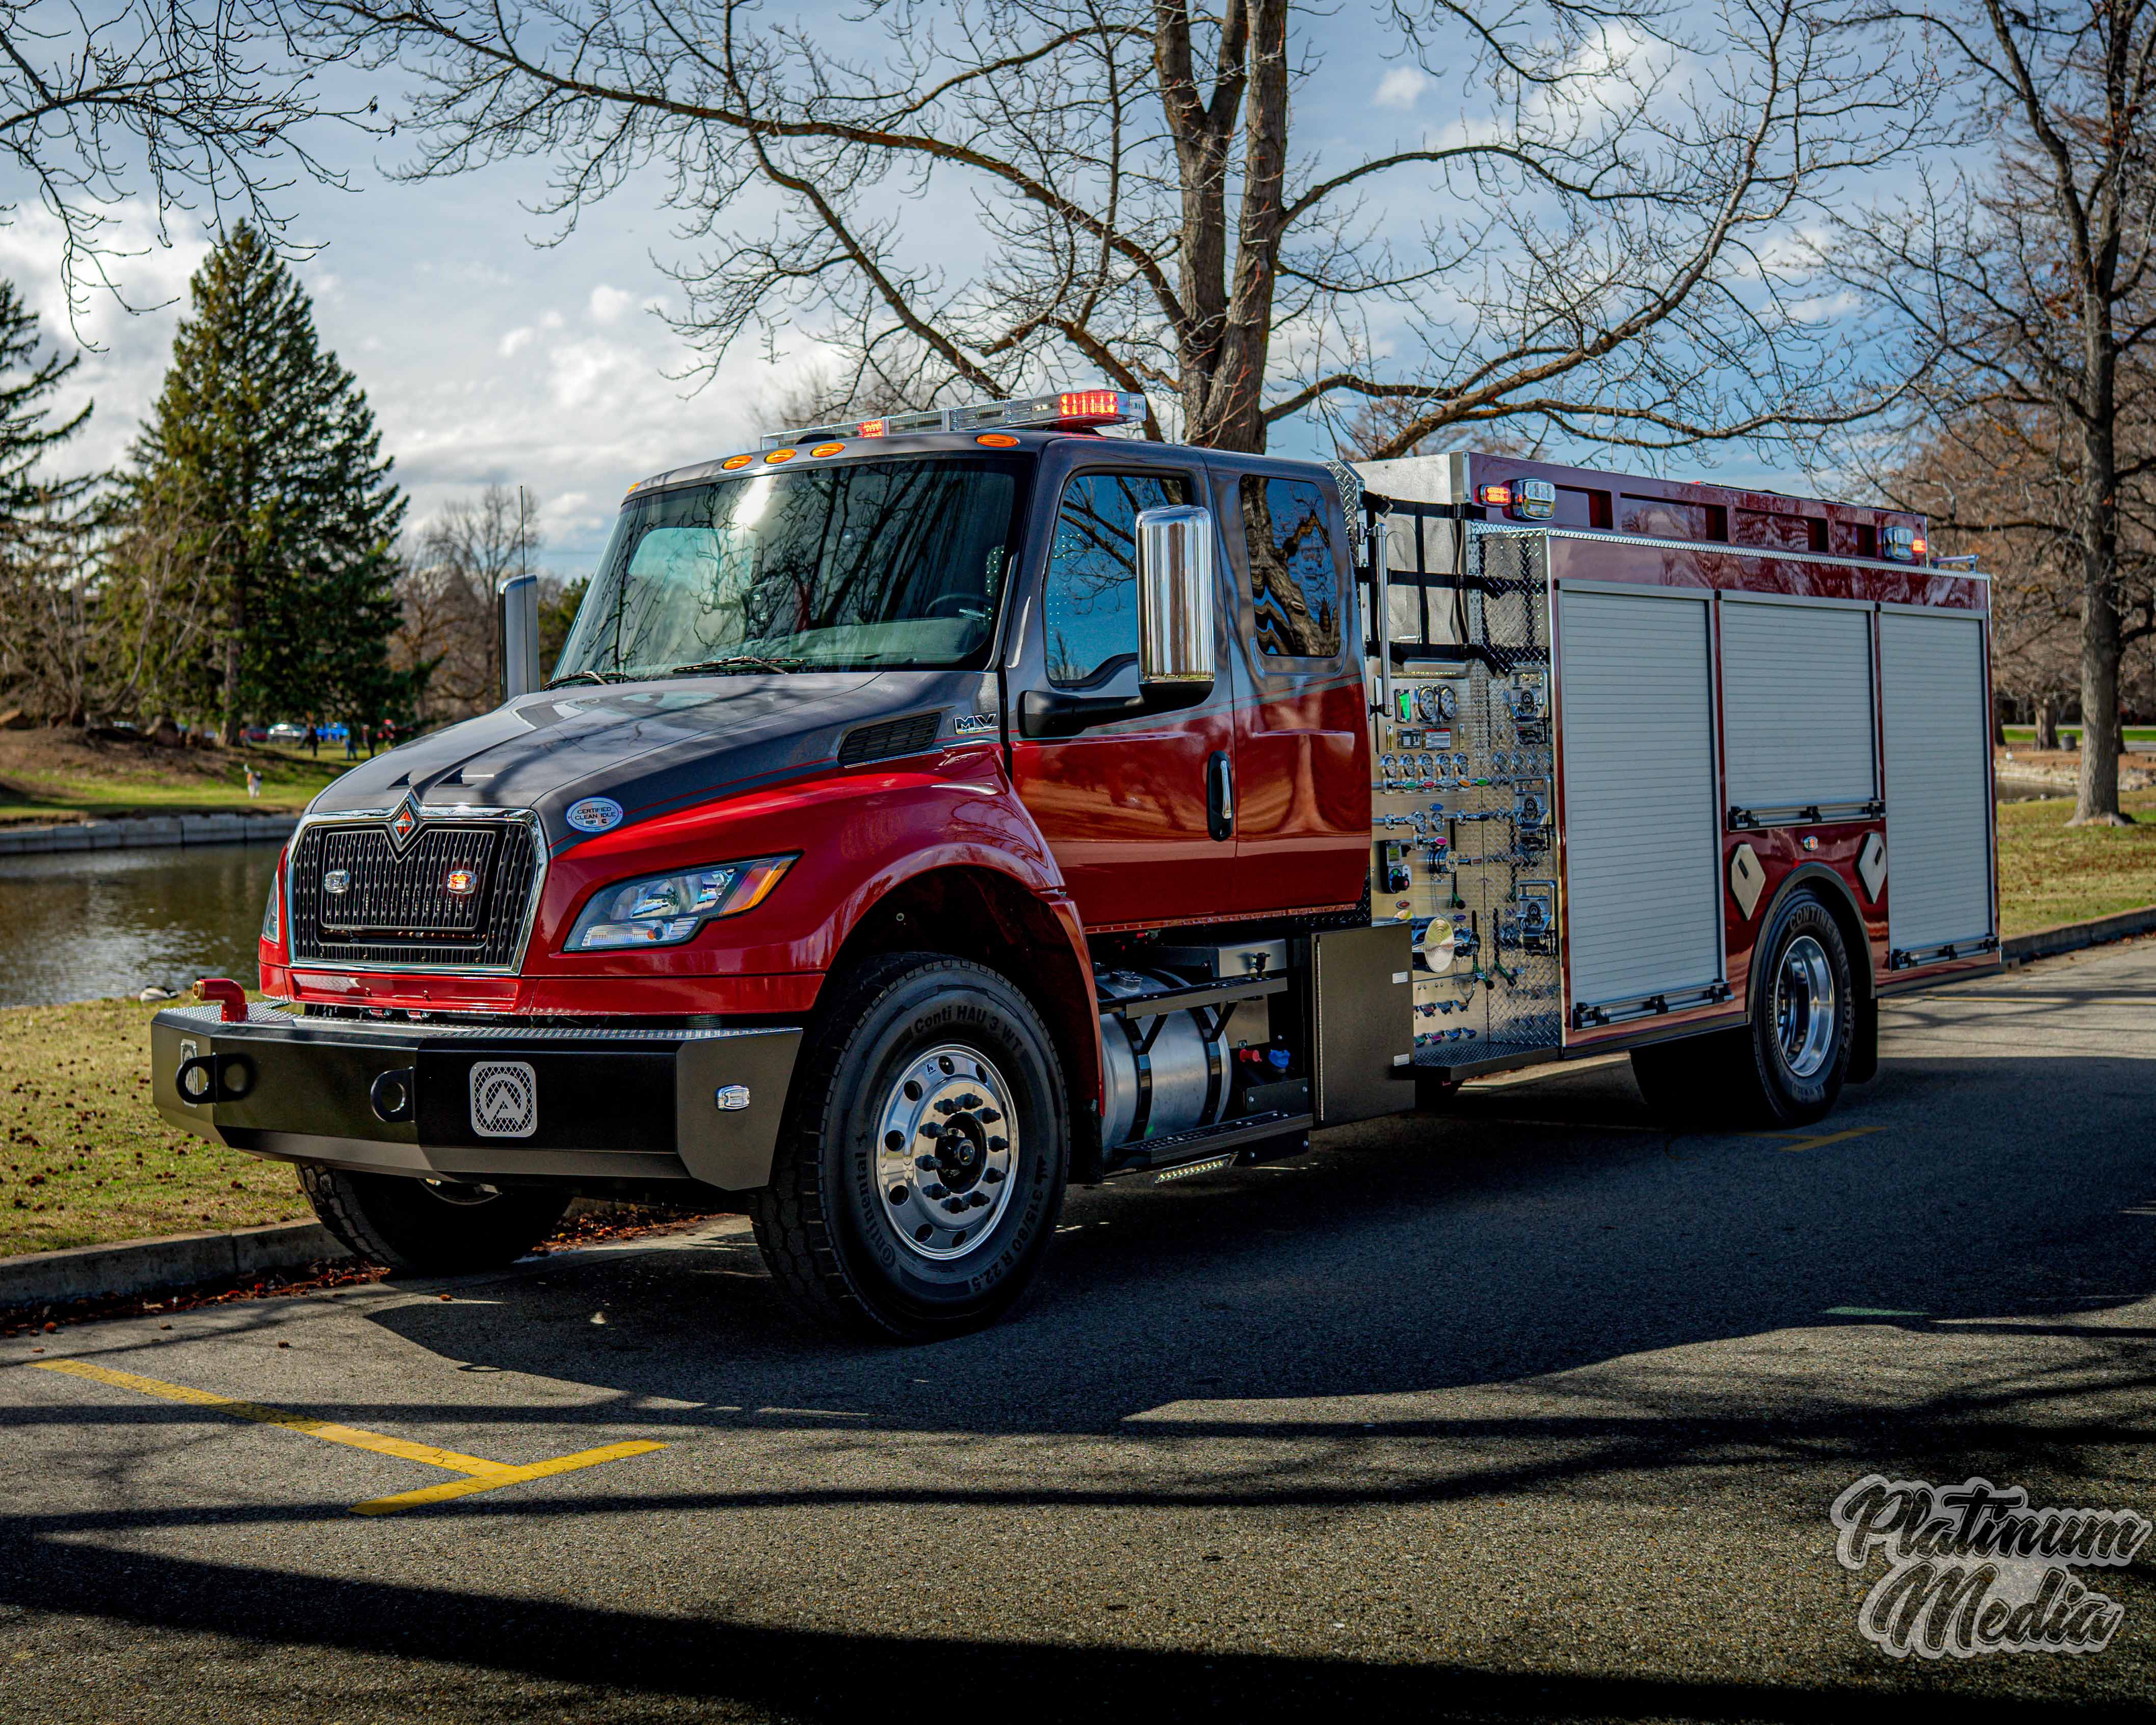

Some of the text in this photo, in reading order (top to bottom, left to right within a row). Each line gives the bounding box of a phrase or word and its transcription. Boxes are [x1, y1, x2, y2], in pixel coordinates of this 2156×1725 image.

[954, 714, 996, 729] MV
[914, 1005, 1022, 1051] Conti HAU 3 WT
[855, 1152, 896, 1268] Continental
[971, 1189, 1043, 1292] 315/80 R 22.5
